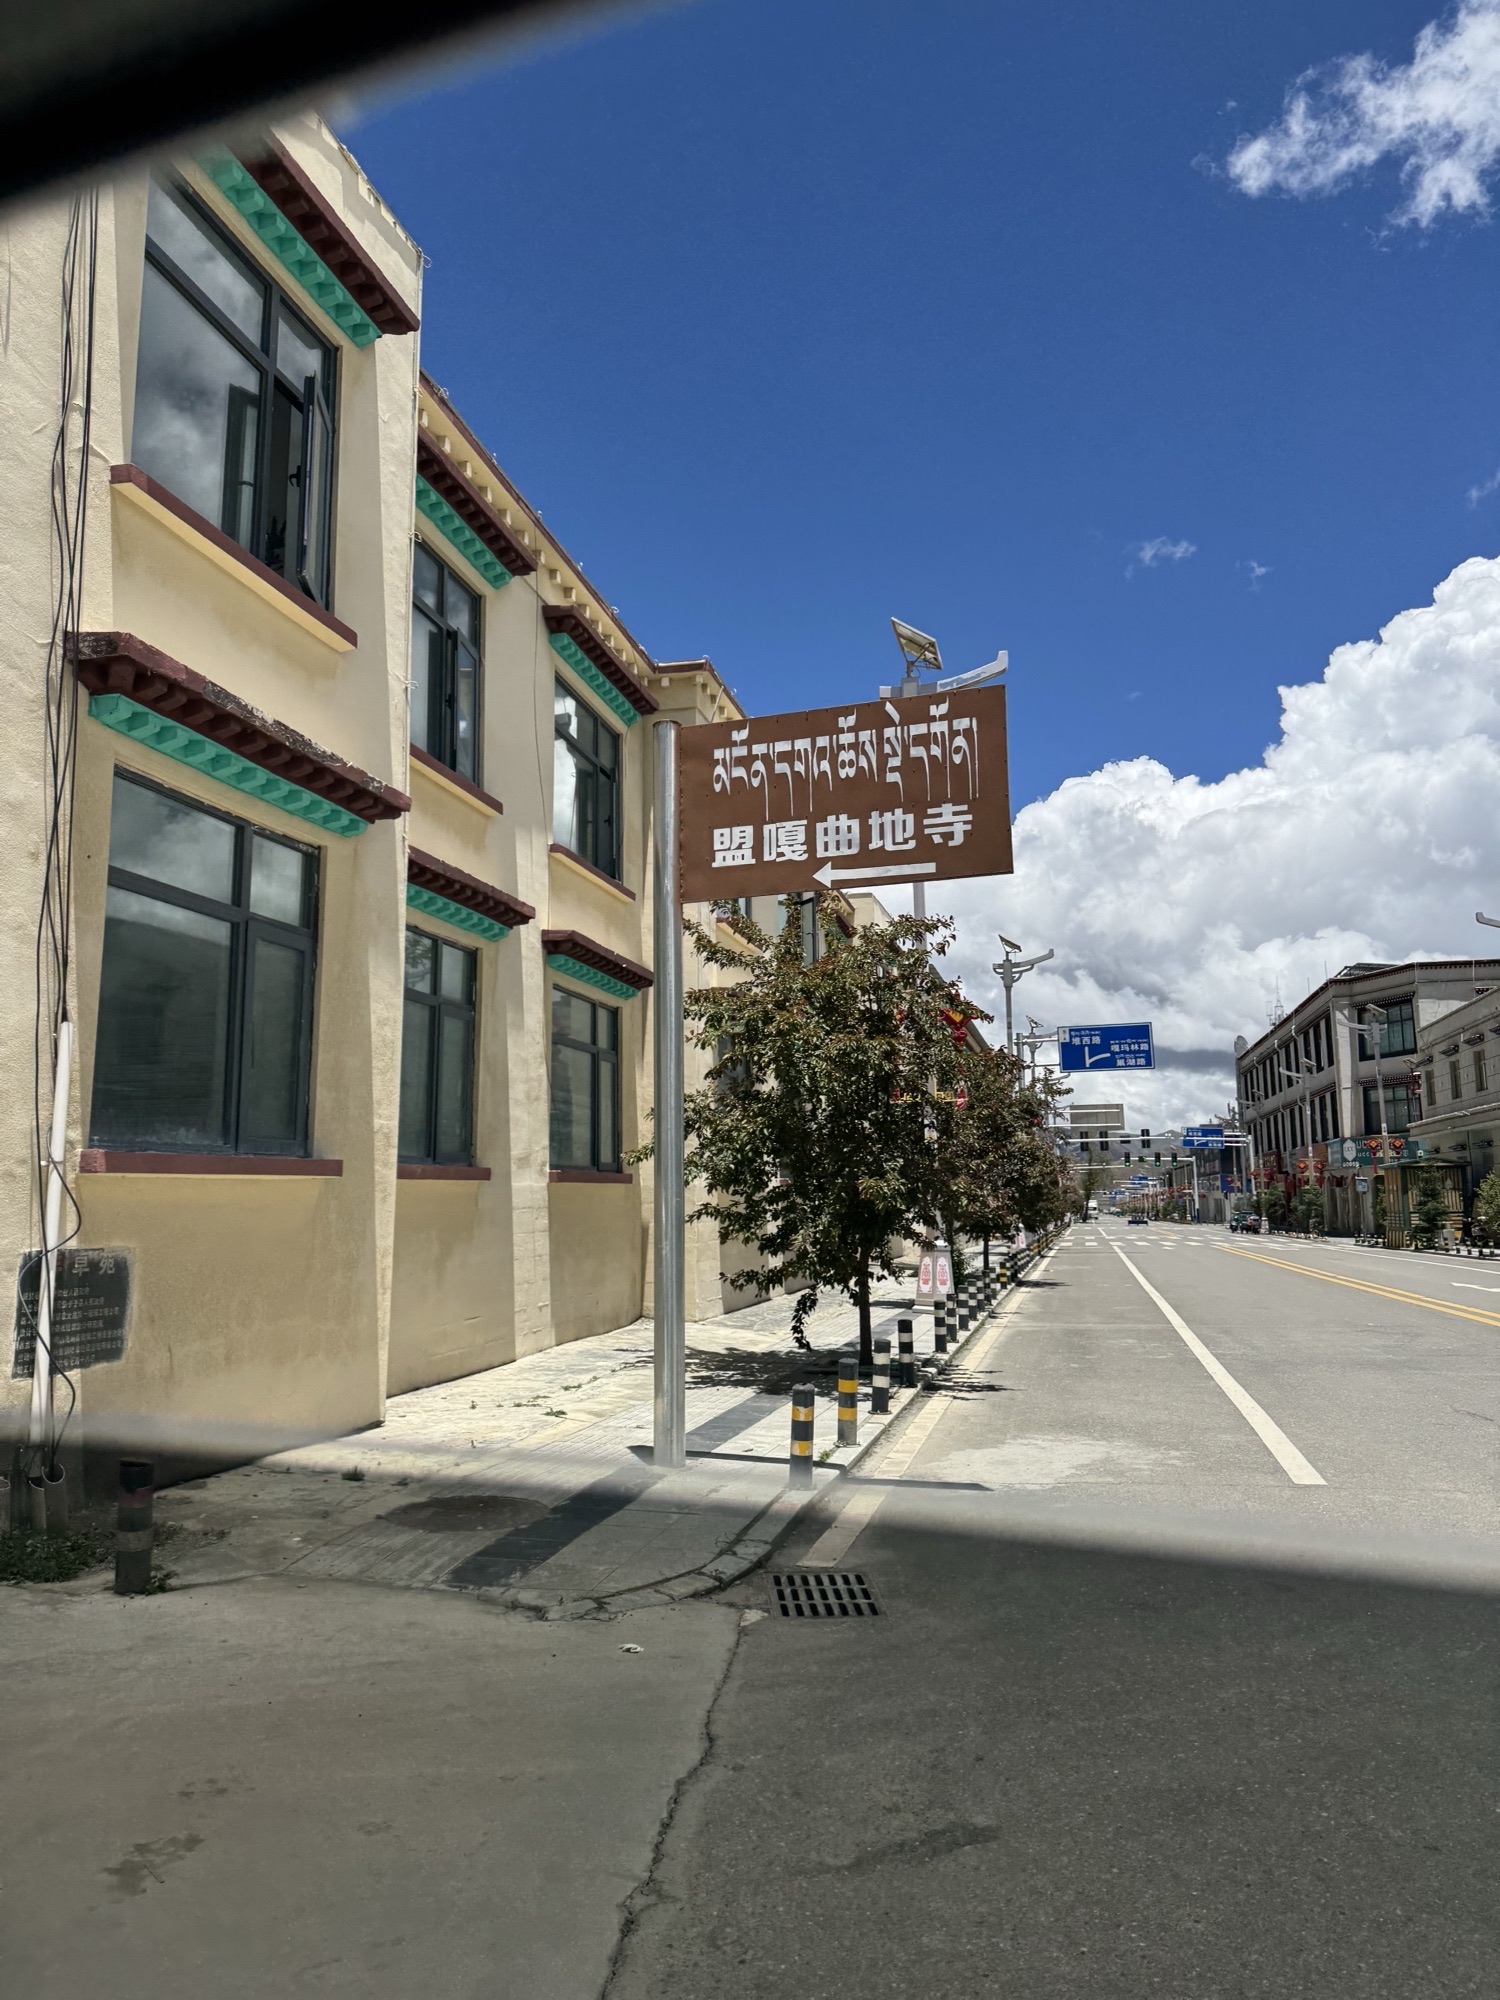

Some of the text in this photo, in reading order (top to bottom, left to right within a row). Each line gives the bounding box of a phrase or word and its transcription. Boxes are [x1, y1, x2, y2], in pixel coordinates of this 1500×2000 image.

[711, 803, 973, 868] 盟嘎曲地寺
[1071, 1036, 1101, 1046] 堆西路
[1110, 1043, 1149, 1052] 嘎玛林路
